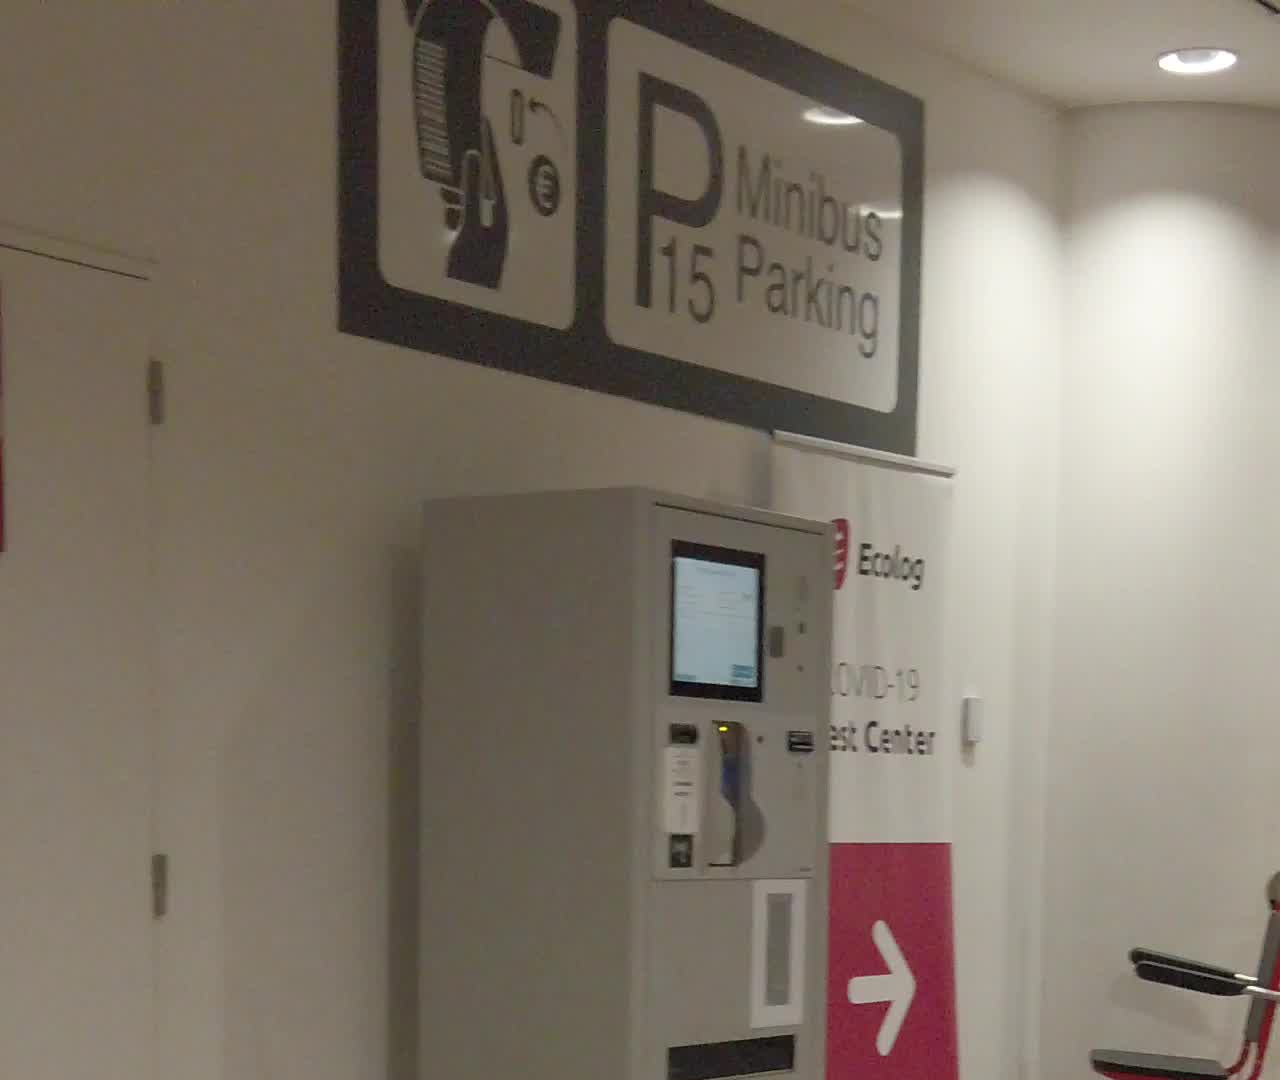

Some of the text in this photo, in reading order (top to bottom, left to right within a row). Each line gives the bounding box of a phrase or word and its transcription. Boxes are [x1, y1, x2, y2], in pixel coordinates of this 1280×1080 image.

[636, 72, 723, 309] P
[735, 144, 884, 263] Minibus
[659, 240, 717, 324] 15
[735, 235, 881, 360] Parking
[857, 543, 925, 591] Ecolog
[830, 661, 921, 702] OVID-19
[829, 720, 936, 756] est Center
